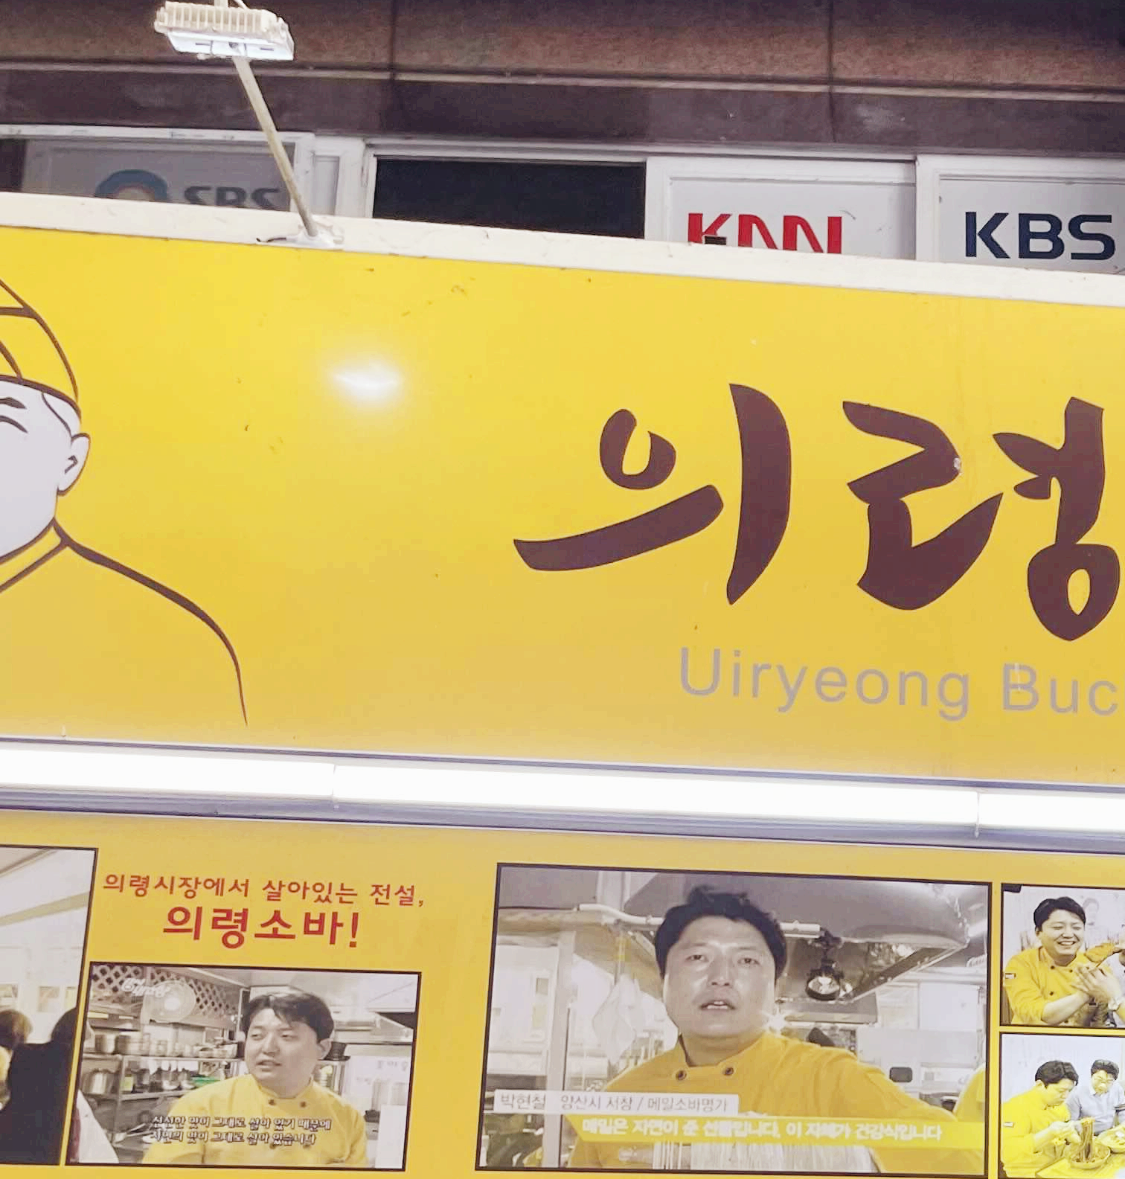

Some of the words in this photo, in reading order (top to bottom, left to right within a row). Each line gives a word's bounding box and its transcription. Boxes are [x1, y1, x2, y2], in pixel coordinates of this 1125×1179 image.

[687, 212, 843, 255] KNN
[965, 211, 1116, 260] KBS
[679, 646, 971, 722] Uiryeong
[103, 873, 250, 899] 의령시장에서
[262, 879, 359, 904] 살아있는
[370, 883, 425, 908] 전설,
[163, 905, 361, 950] 의령소바!
